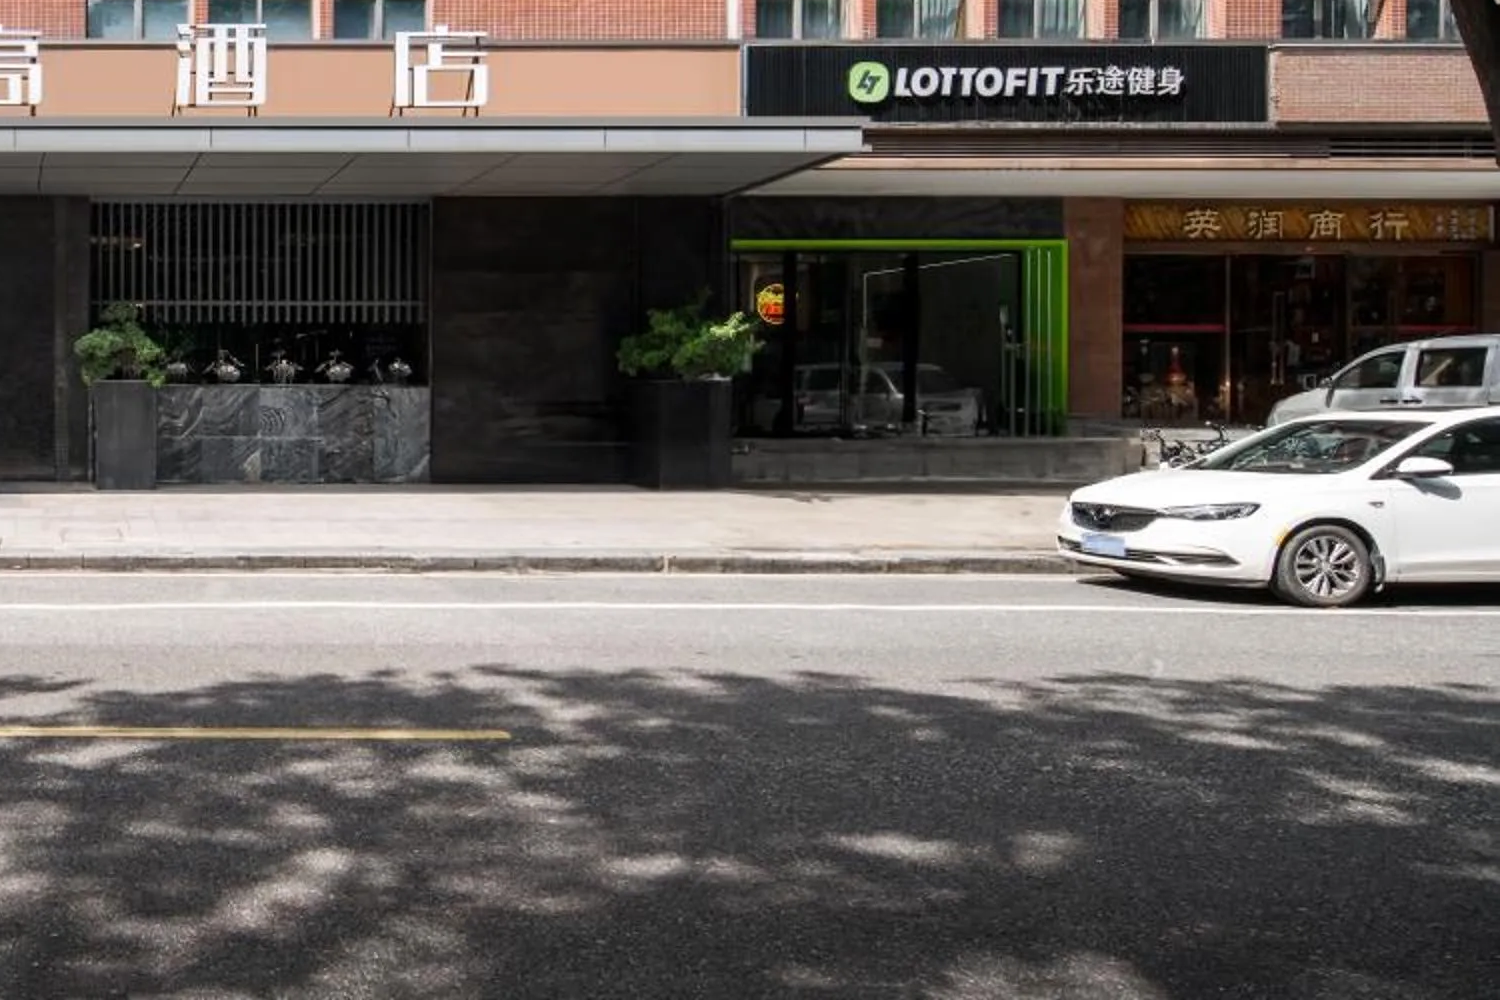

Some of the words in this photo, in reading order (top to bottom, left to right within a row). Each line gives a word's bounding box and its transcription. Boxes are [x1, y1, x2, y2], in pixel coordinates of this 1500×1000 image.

[894, 66, 1065, 98] LOTTOFIT
[1066, 63, 1185, 96] 乐途健身
[1184, 208, 1410, 240] 英润商行
